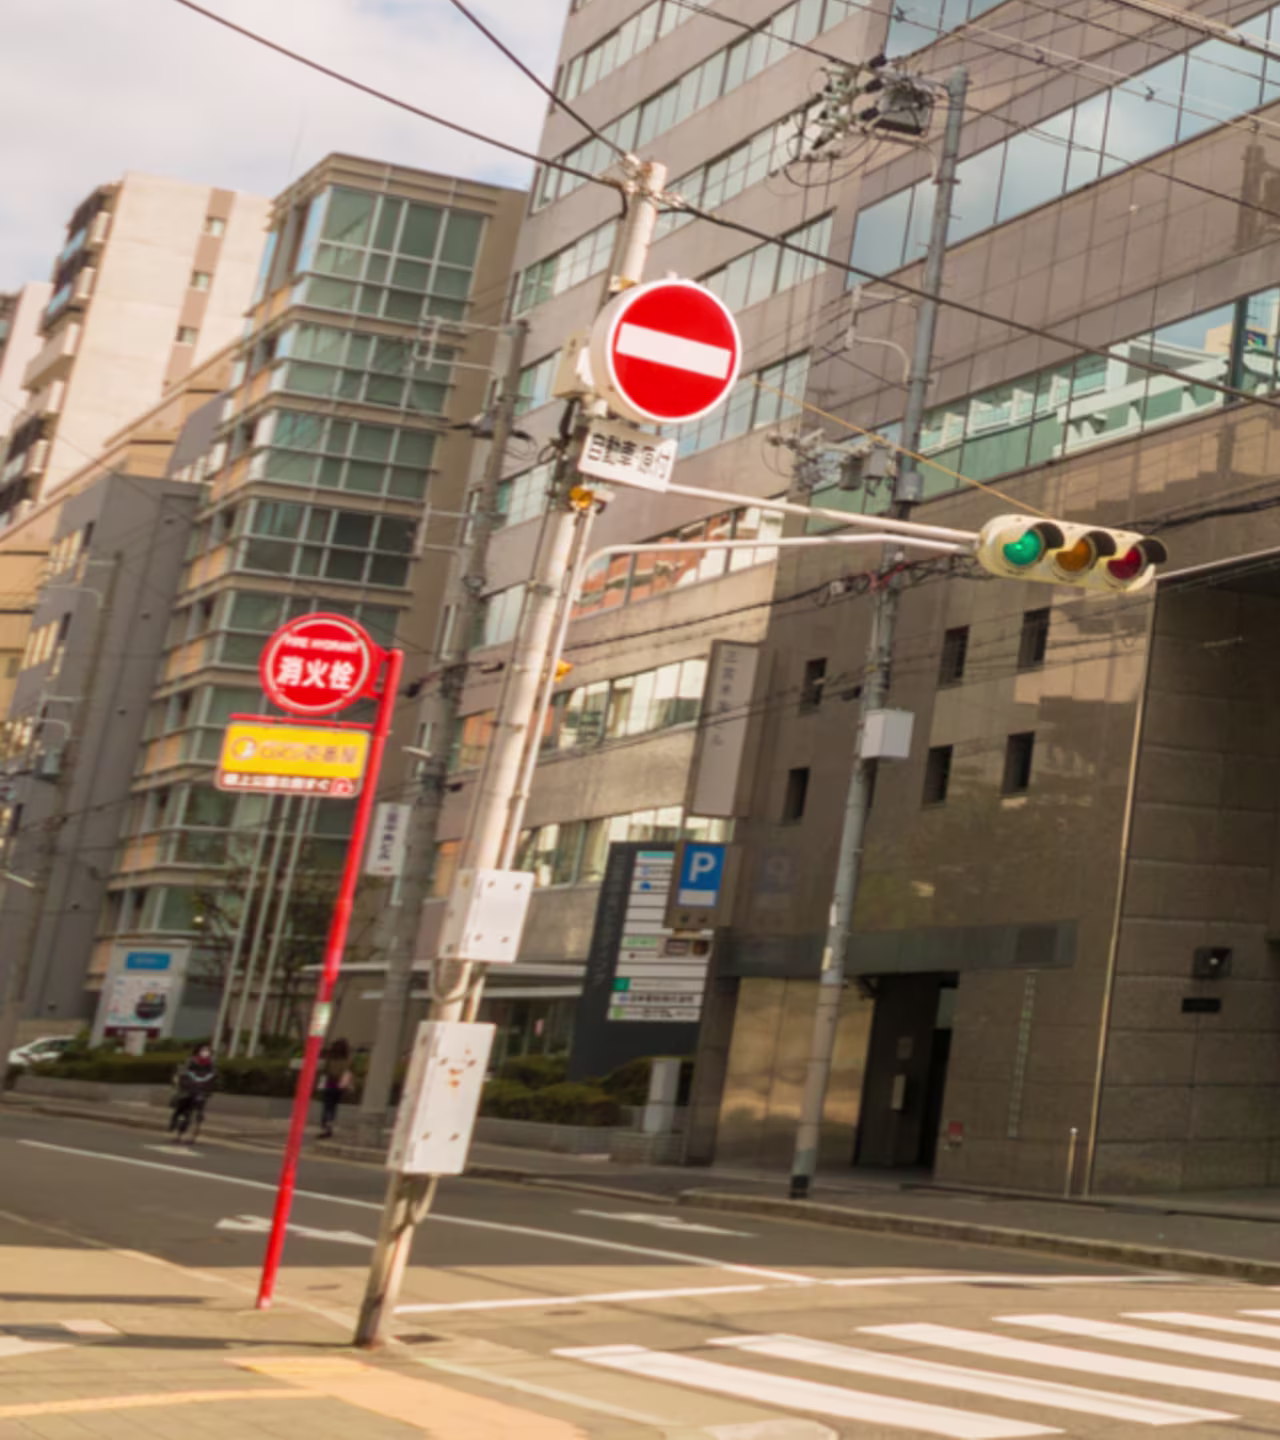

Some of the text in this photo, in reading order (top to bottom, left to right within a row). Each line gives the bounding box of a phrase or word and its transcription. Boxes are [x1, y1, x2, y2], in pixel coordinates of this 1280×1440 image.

[276, 656, 355, 690] 消火栓
[688, 851, 718, 884] P
